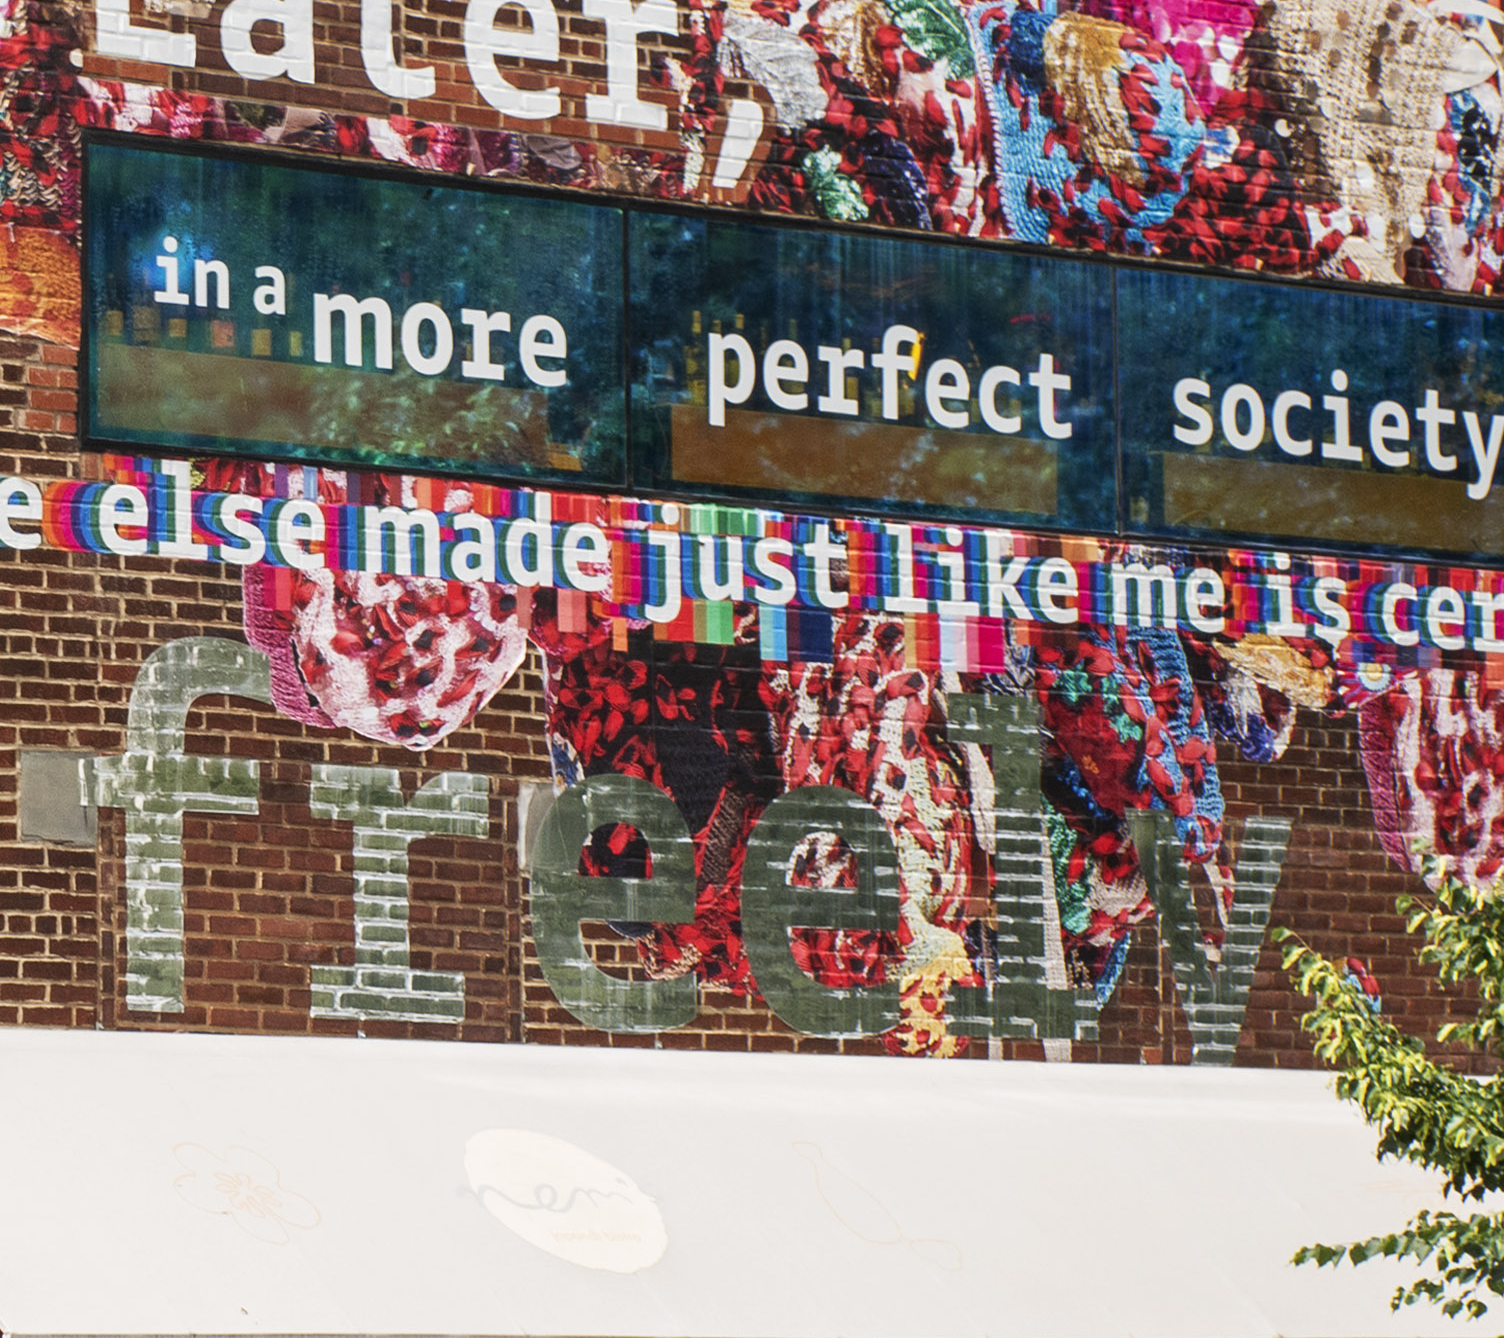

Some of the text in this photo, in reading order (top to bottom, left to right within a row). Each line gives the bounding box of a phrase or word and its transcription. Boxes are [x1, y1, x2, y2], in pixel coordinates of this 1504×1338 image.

[154, 237, 231, 312] in
[254, 267, 287, 316] a
[314, 291, 569, 387] more
[709, 325, 1073, 441] perfect
[98, 460, 326, 568] else
[353, 491, 609, 589] made
[638, 503, 849, 622] just
[884, 523, 1078, 625] like
[1112, 566, 1226, 634] me
[1264, 553, 1353, 641] is
[79, 636, 1292, 1065] freely
